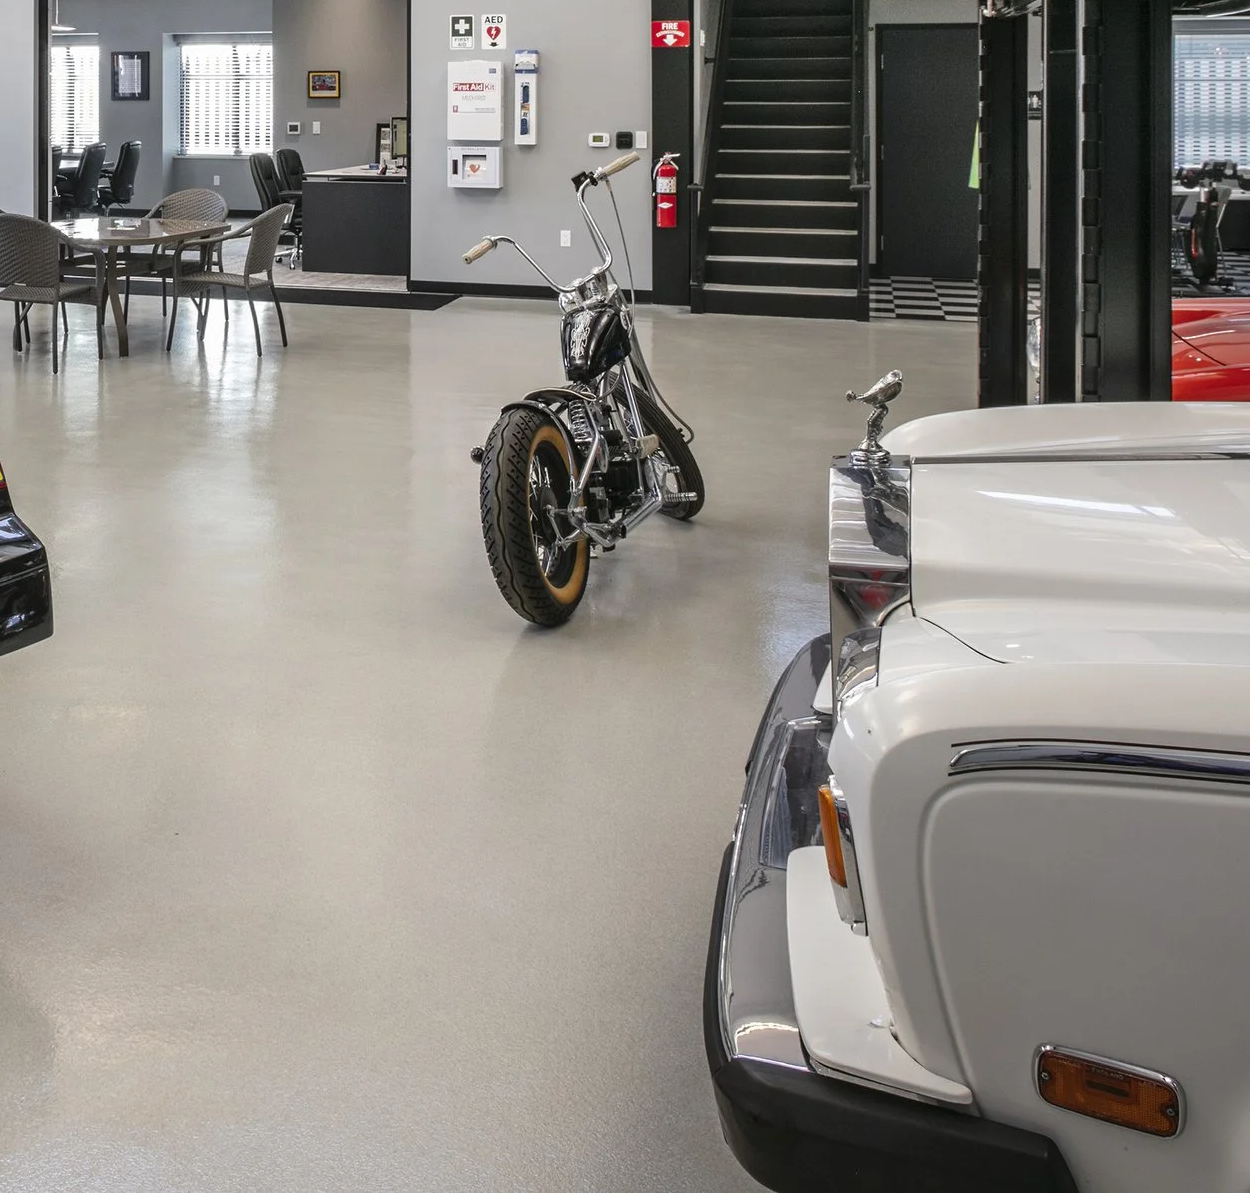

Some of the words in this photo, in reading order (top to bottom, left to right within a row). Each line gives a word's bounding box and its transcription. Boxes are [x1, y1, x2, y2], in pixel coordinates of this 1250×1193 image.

[484, 16, 503, 24] AED
[661, 22, 679, 30] FIRE
[453, 83, 469, 91] First
[470, 83, 483, 91] Aid
